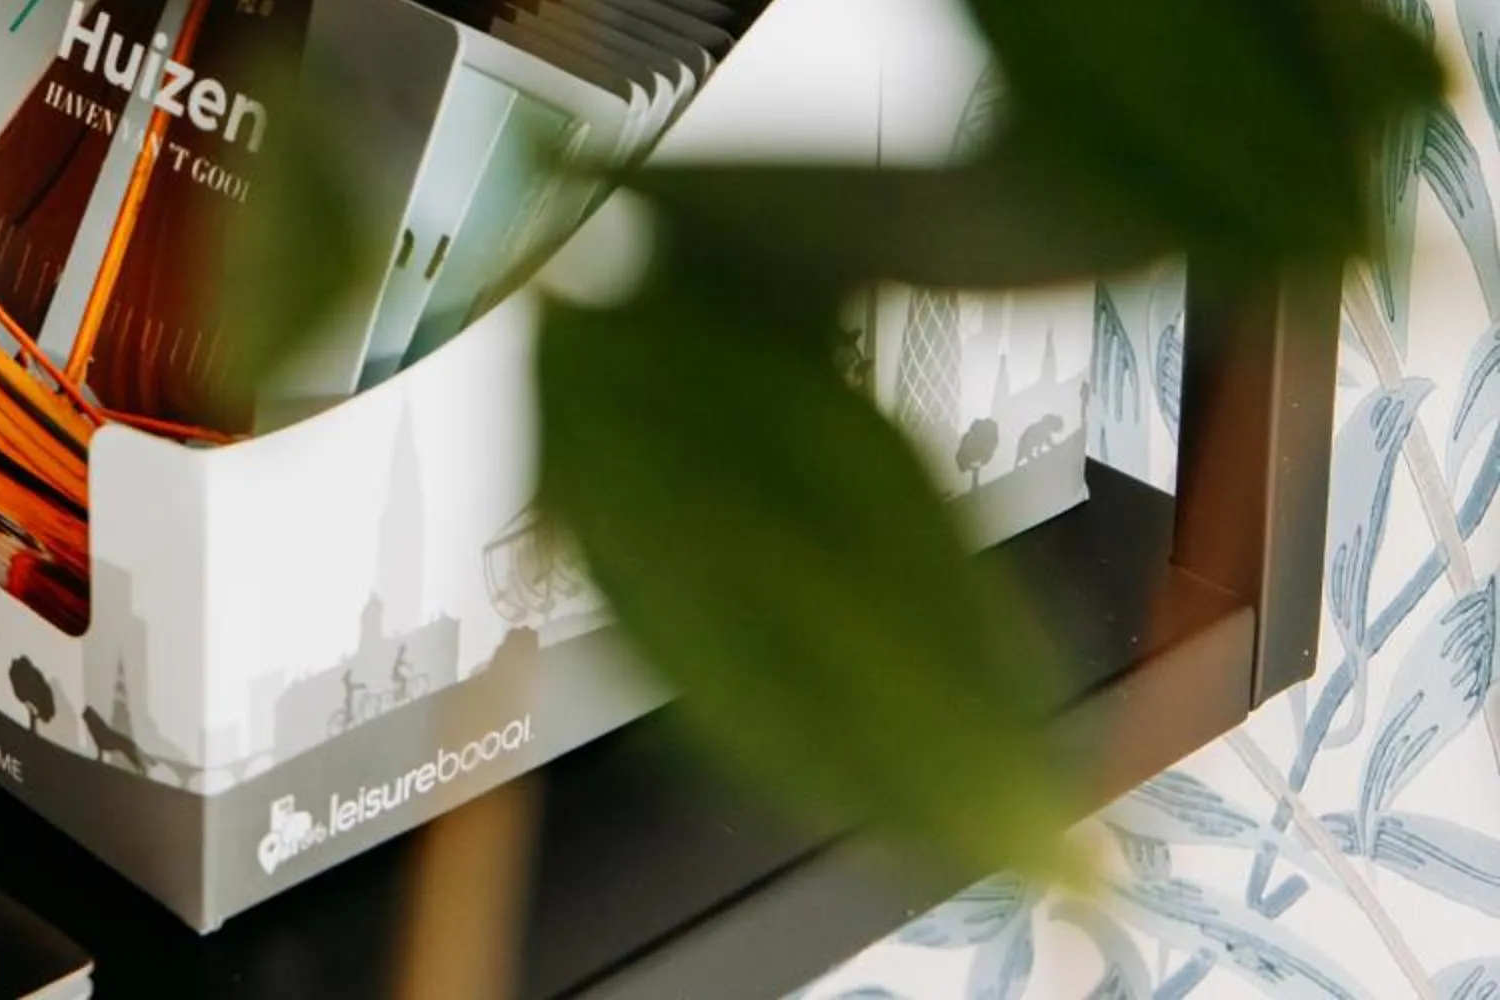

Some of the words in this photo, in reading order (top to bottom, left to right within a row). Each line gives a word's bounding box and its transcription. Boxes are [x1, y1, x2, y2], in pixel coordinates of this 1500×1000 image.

[44, 81, 117, 137] HAVEN
[191, 151, 251, 204] GOOI
[57, 0, 268, 152] Huizen
